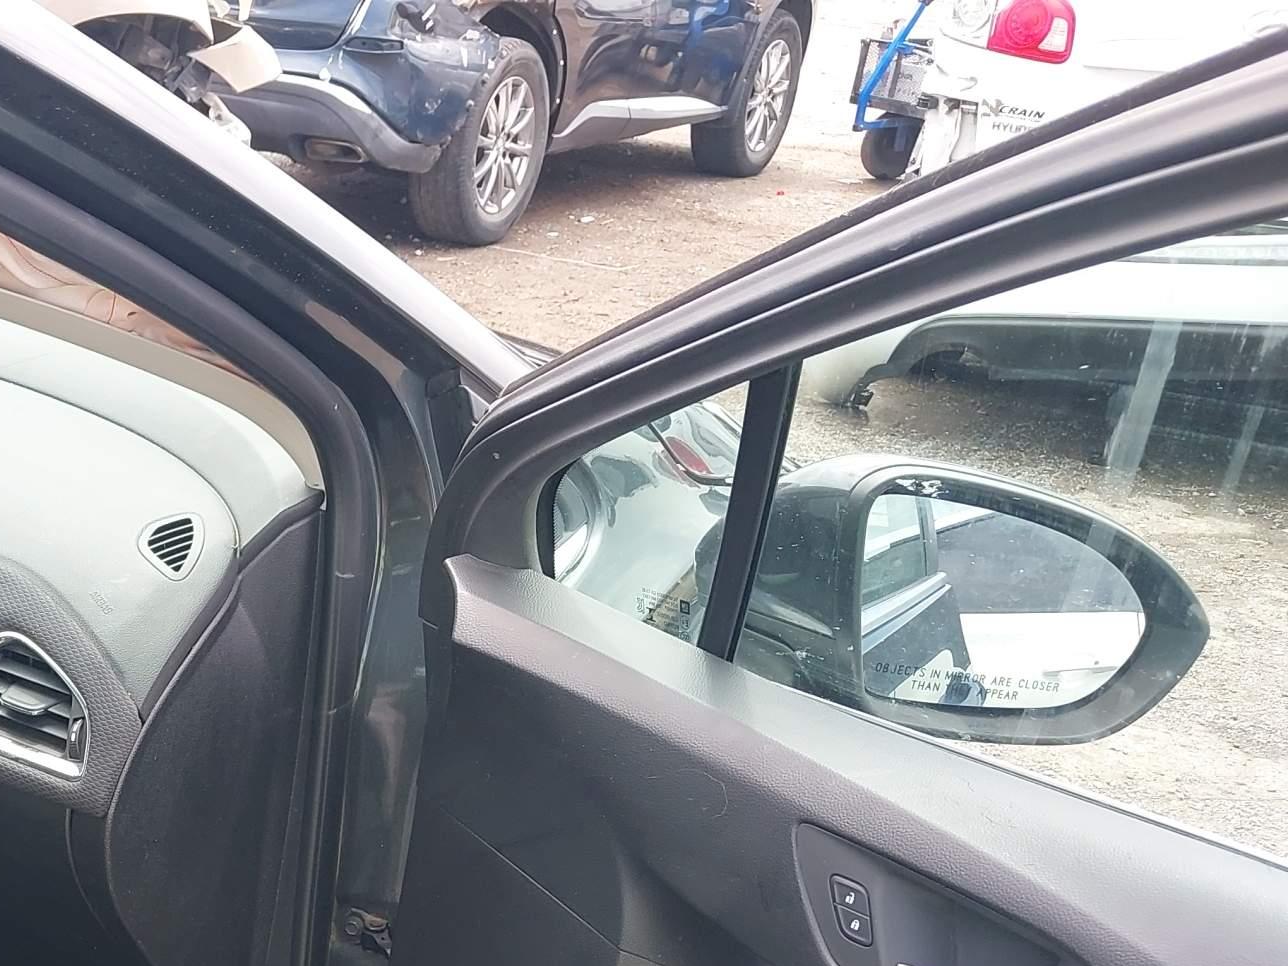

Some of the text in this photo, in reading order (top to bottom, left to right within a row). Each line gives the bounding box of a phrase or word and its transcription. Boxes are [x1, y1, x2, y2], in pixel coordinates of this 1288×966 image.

[999, 105, 1046, 119] CRAIN
[875, 662, 1060, 693] OBJECTS IN MIRROR ARE CLOSER
[911, 679, 941, 692] THAN
[976, 687, 1019, 701] APPEAR
